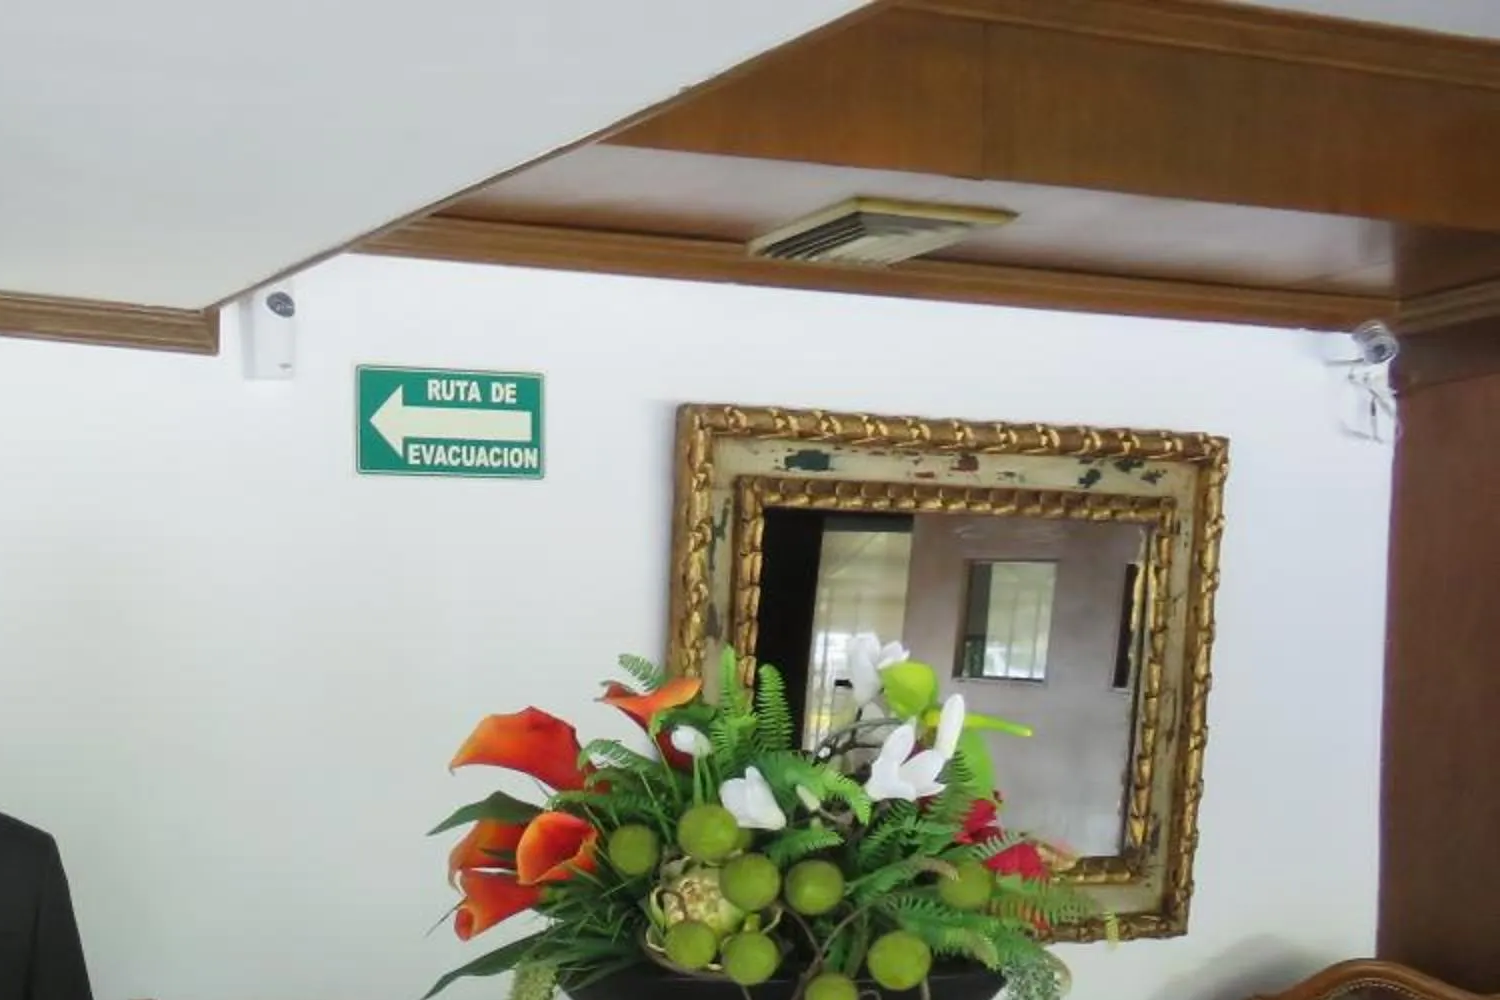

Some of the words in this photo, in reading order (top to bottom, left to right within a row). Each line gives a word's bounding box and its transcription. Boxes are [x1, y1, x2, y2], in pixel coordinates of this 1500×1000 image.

[427, 379, 482, 402] RUTA
[491, 381, 517, 404] DE
[408, 444, 538, 469] EVACUACION
